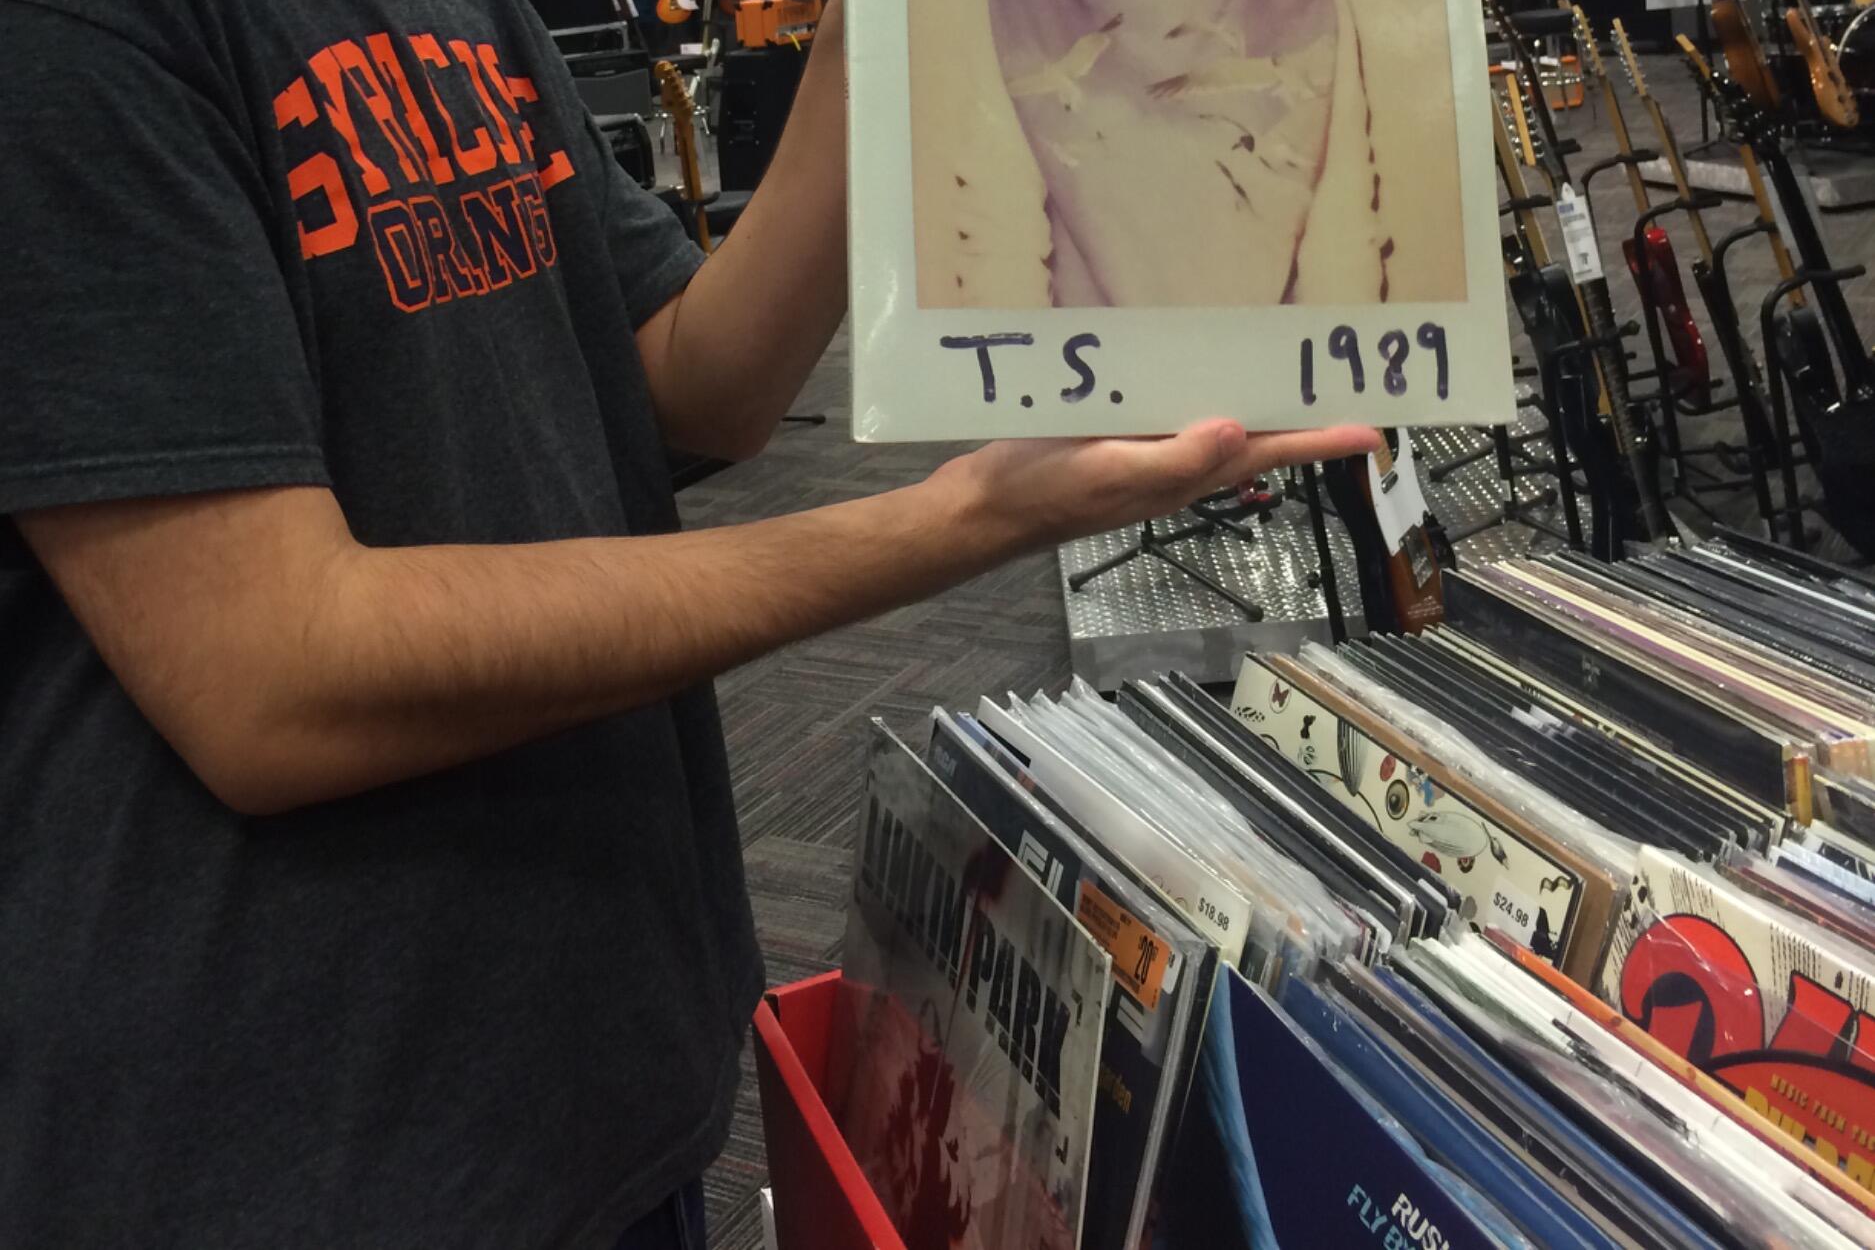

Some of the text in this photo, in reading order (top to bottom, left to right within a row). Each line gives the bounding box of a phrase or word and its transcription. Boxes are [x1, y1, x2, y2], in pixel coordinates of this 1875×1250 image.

[1300, 322, 1449, 406] 1989
[1197, 896, 1230, 932] $18.98
[1492, 891, 1530, 928] $24.98
[965, 908, 1072, 1120] PARK
[1346, 1183, 1388, 1234] FLY
[1391, 1192, 1450, 1250] RUS
